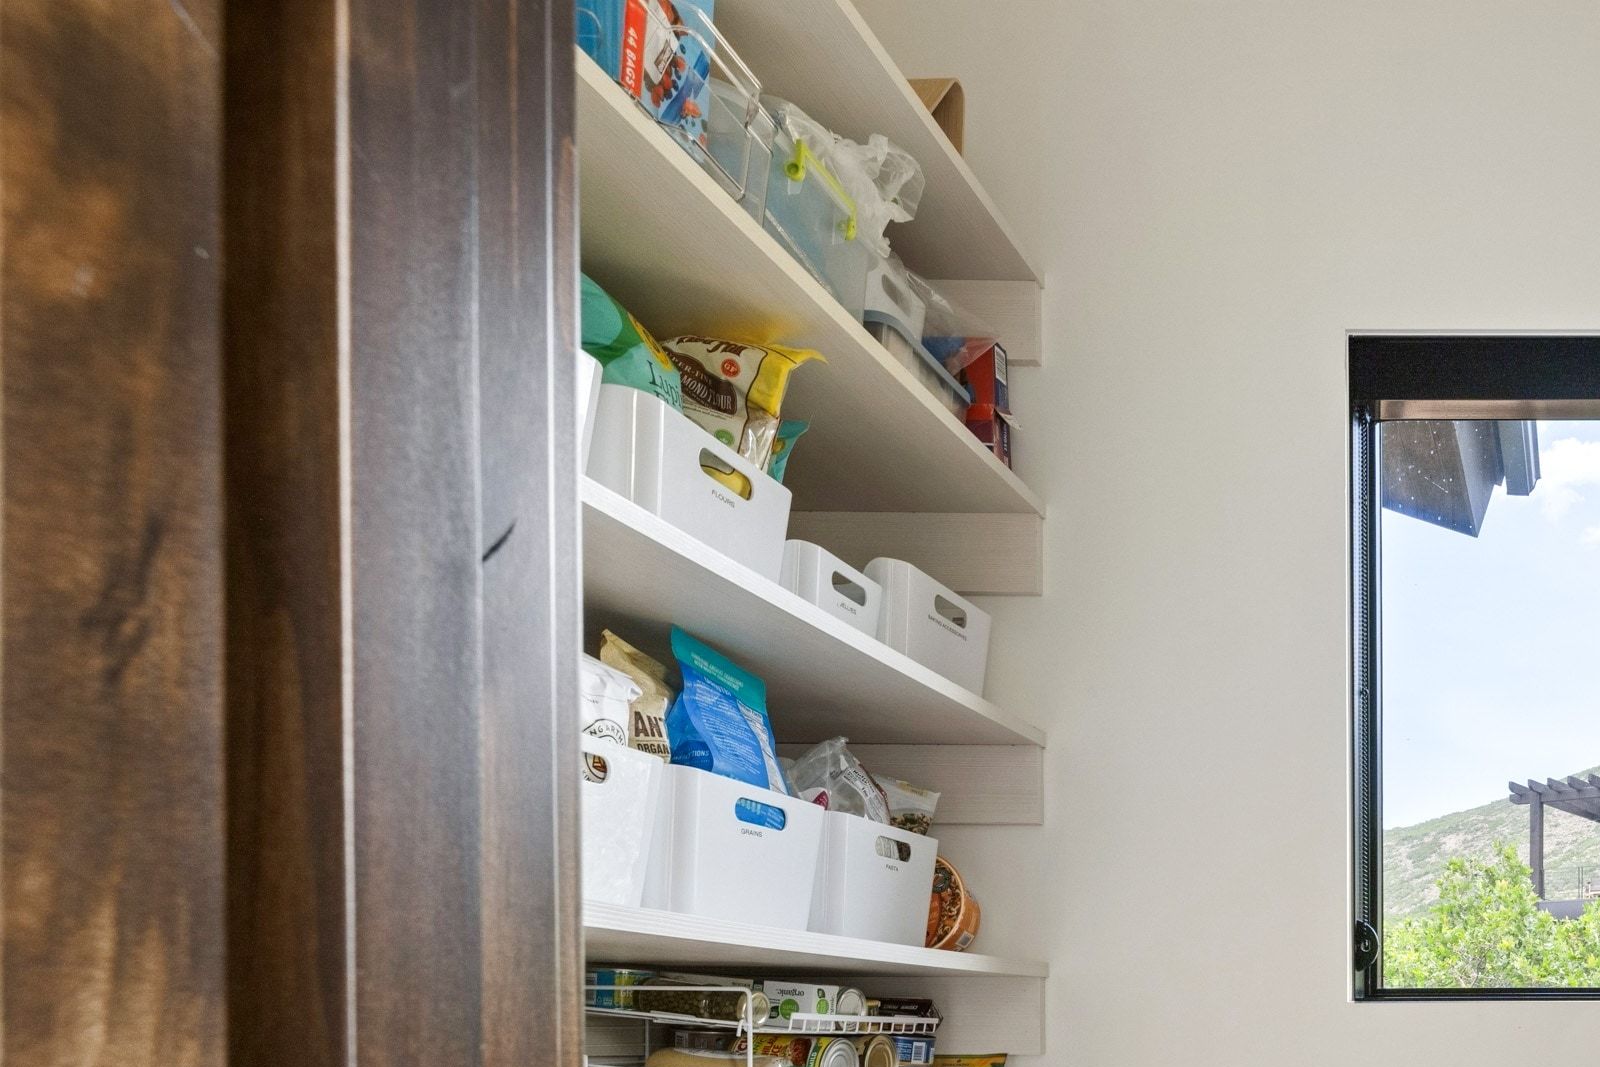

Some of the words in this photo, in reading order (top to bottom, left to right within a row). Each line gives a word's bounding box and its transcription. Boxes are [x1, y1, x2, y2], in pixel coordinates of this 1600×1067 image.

[627, 27, 638, 48] 44
[625, 48, 637, 88] BAGS
[740, 828, 763, 838] GRAINS
[885, 863, 899, 872] PASTA
[808, 1051, 818, 1067] MILD
